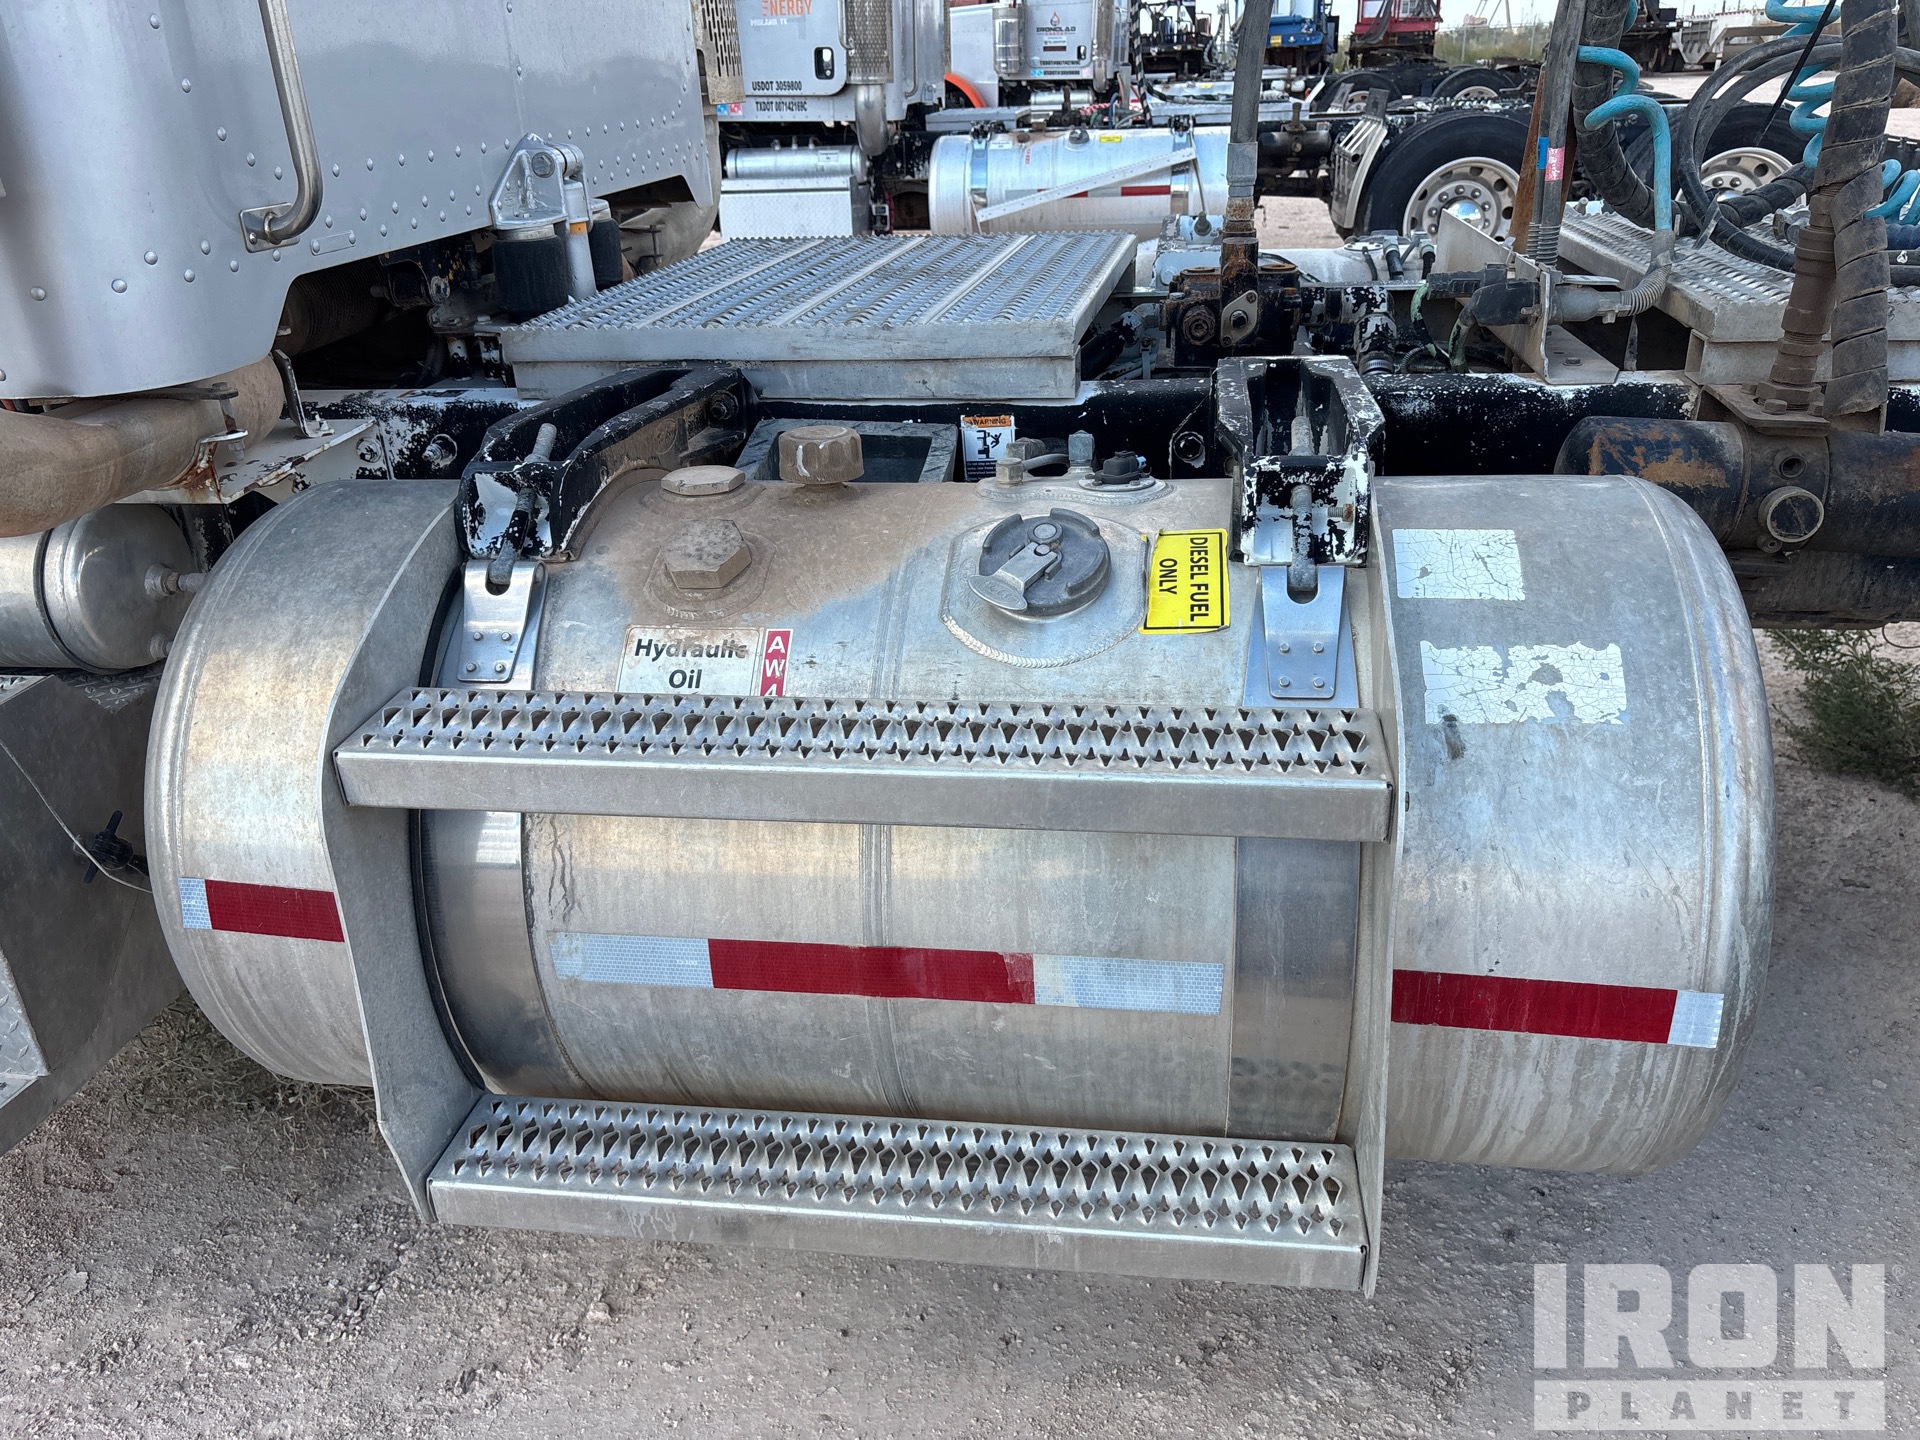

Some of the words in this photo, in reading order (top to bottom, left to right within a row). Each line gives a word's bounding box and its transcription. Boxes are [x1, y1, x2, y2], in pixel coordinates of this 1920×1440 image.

[761, 0, 812, 16] ENERGY
[751, 81, 774, 91] USDOT
[755, 101, 773, 112] TXDOT
[973, 417, 1007, 426] WARNING
[1189, 537, 1208, 580] DIESEL
[1159, 558, 1177, 595] ONLY
[1189, 583, 1209, 622] FUEL
[634, 638, 748, 662] Hydraulic
[668, 669, 703, 689] Oil
